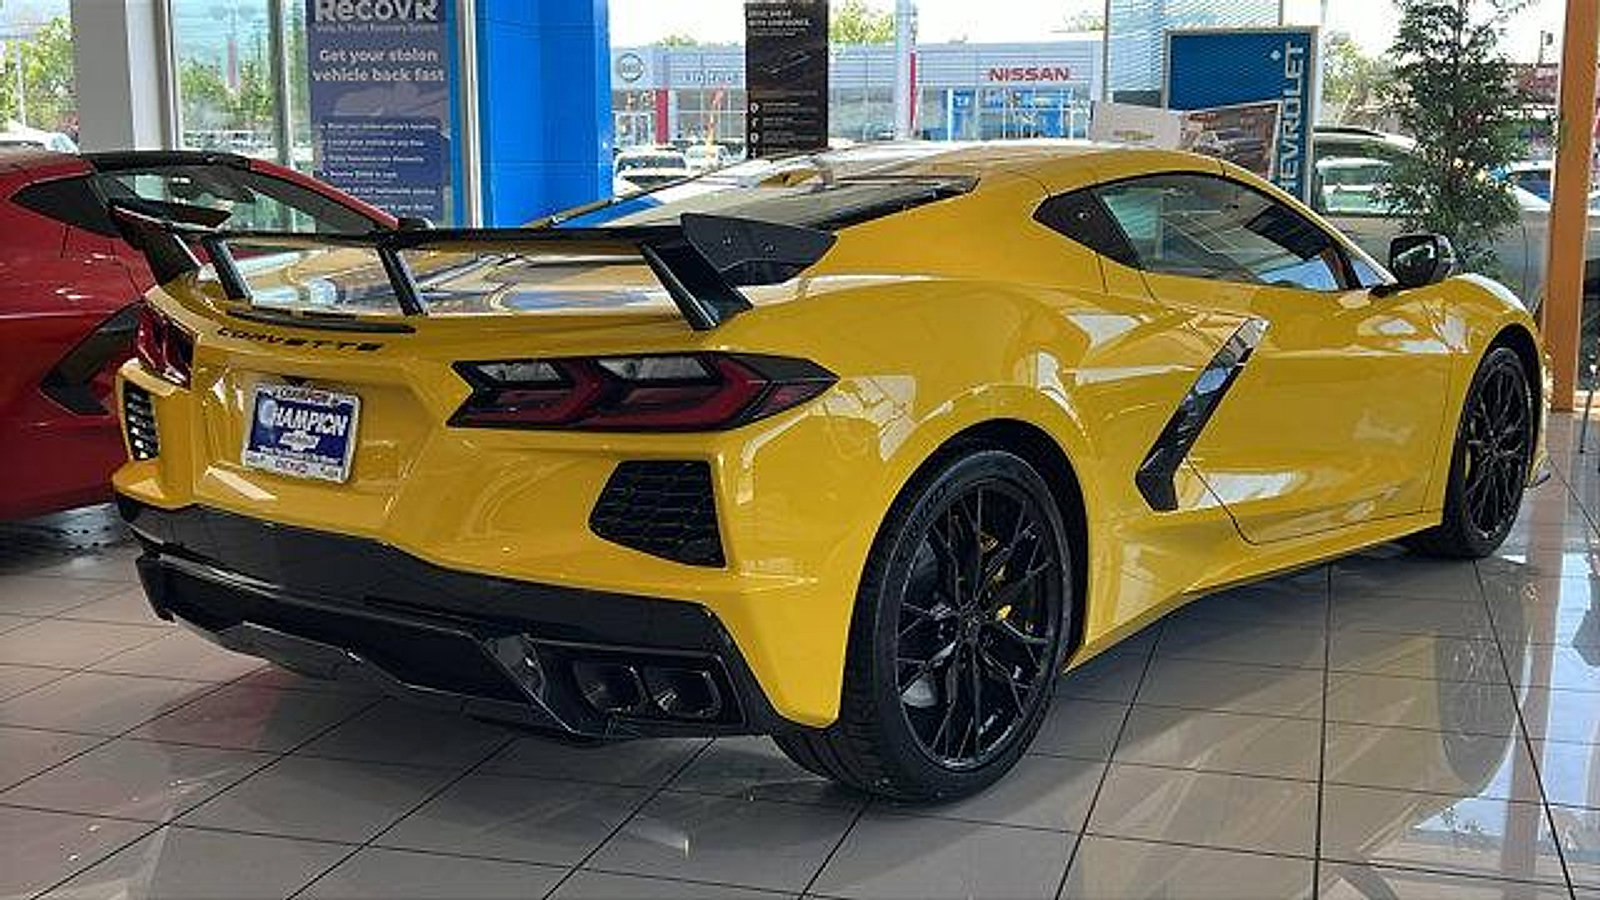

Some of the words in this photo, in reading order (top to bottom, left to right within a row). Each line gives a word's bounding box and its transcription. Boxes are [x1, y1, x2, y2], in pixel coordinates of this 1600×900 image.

[320, 49, 347, 61] Get
[349, 51, 385, 65] your
[389, 48, 439, 61] stolen
[313, 68, 369, 81] vehicle
[372, 68, 413, 81] back
[414, 68, 445, 82] fast
[990, 67, 1069, 81] NISSAN
[1279, 41, 1305, 192] HEVROLET
[217, 327, 384, 352] CORVETTE
[258, 400, 349, 436] CHAMPION
